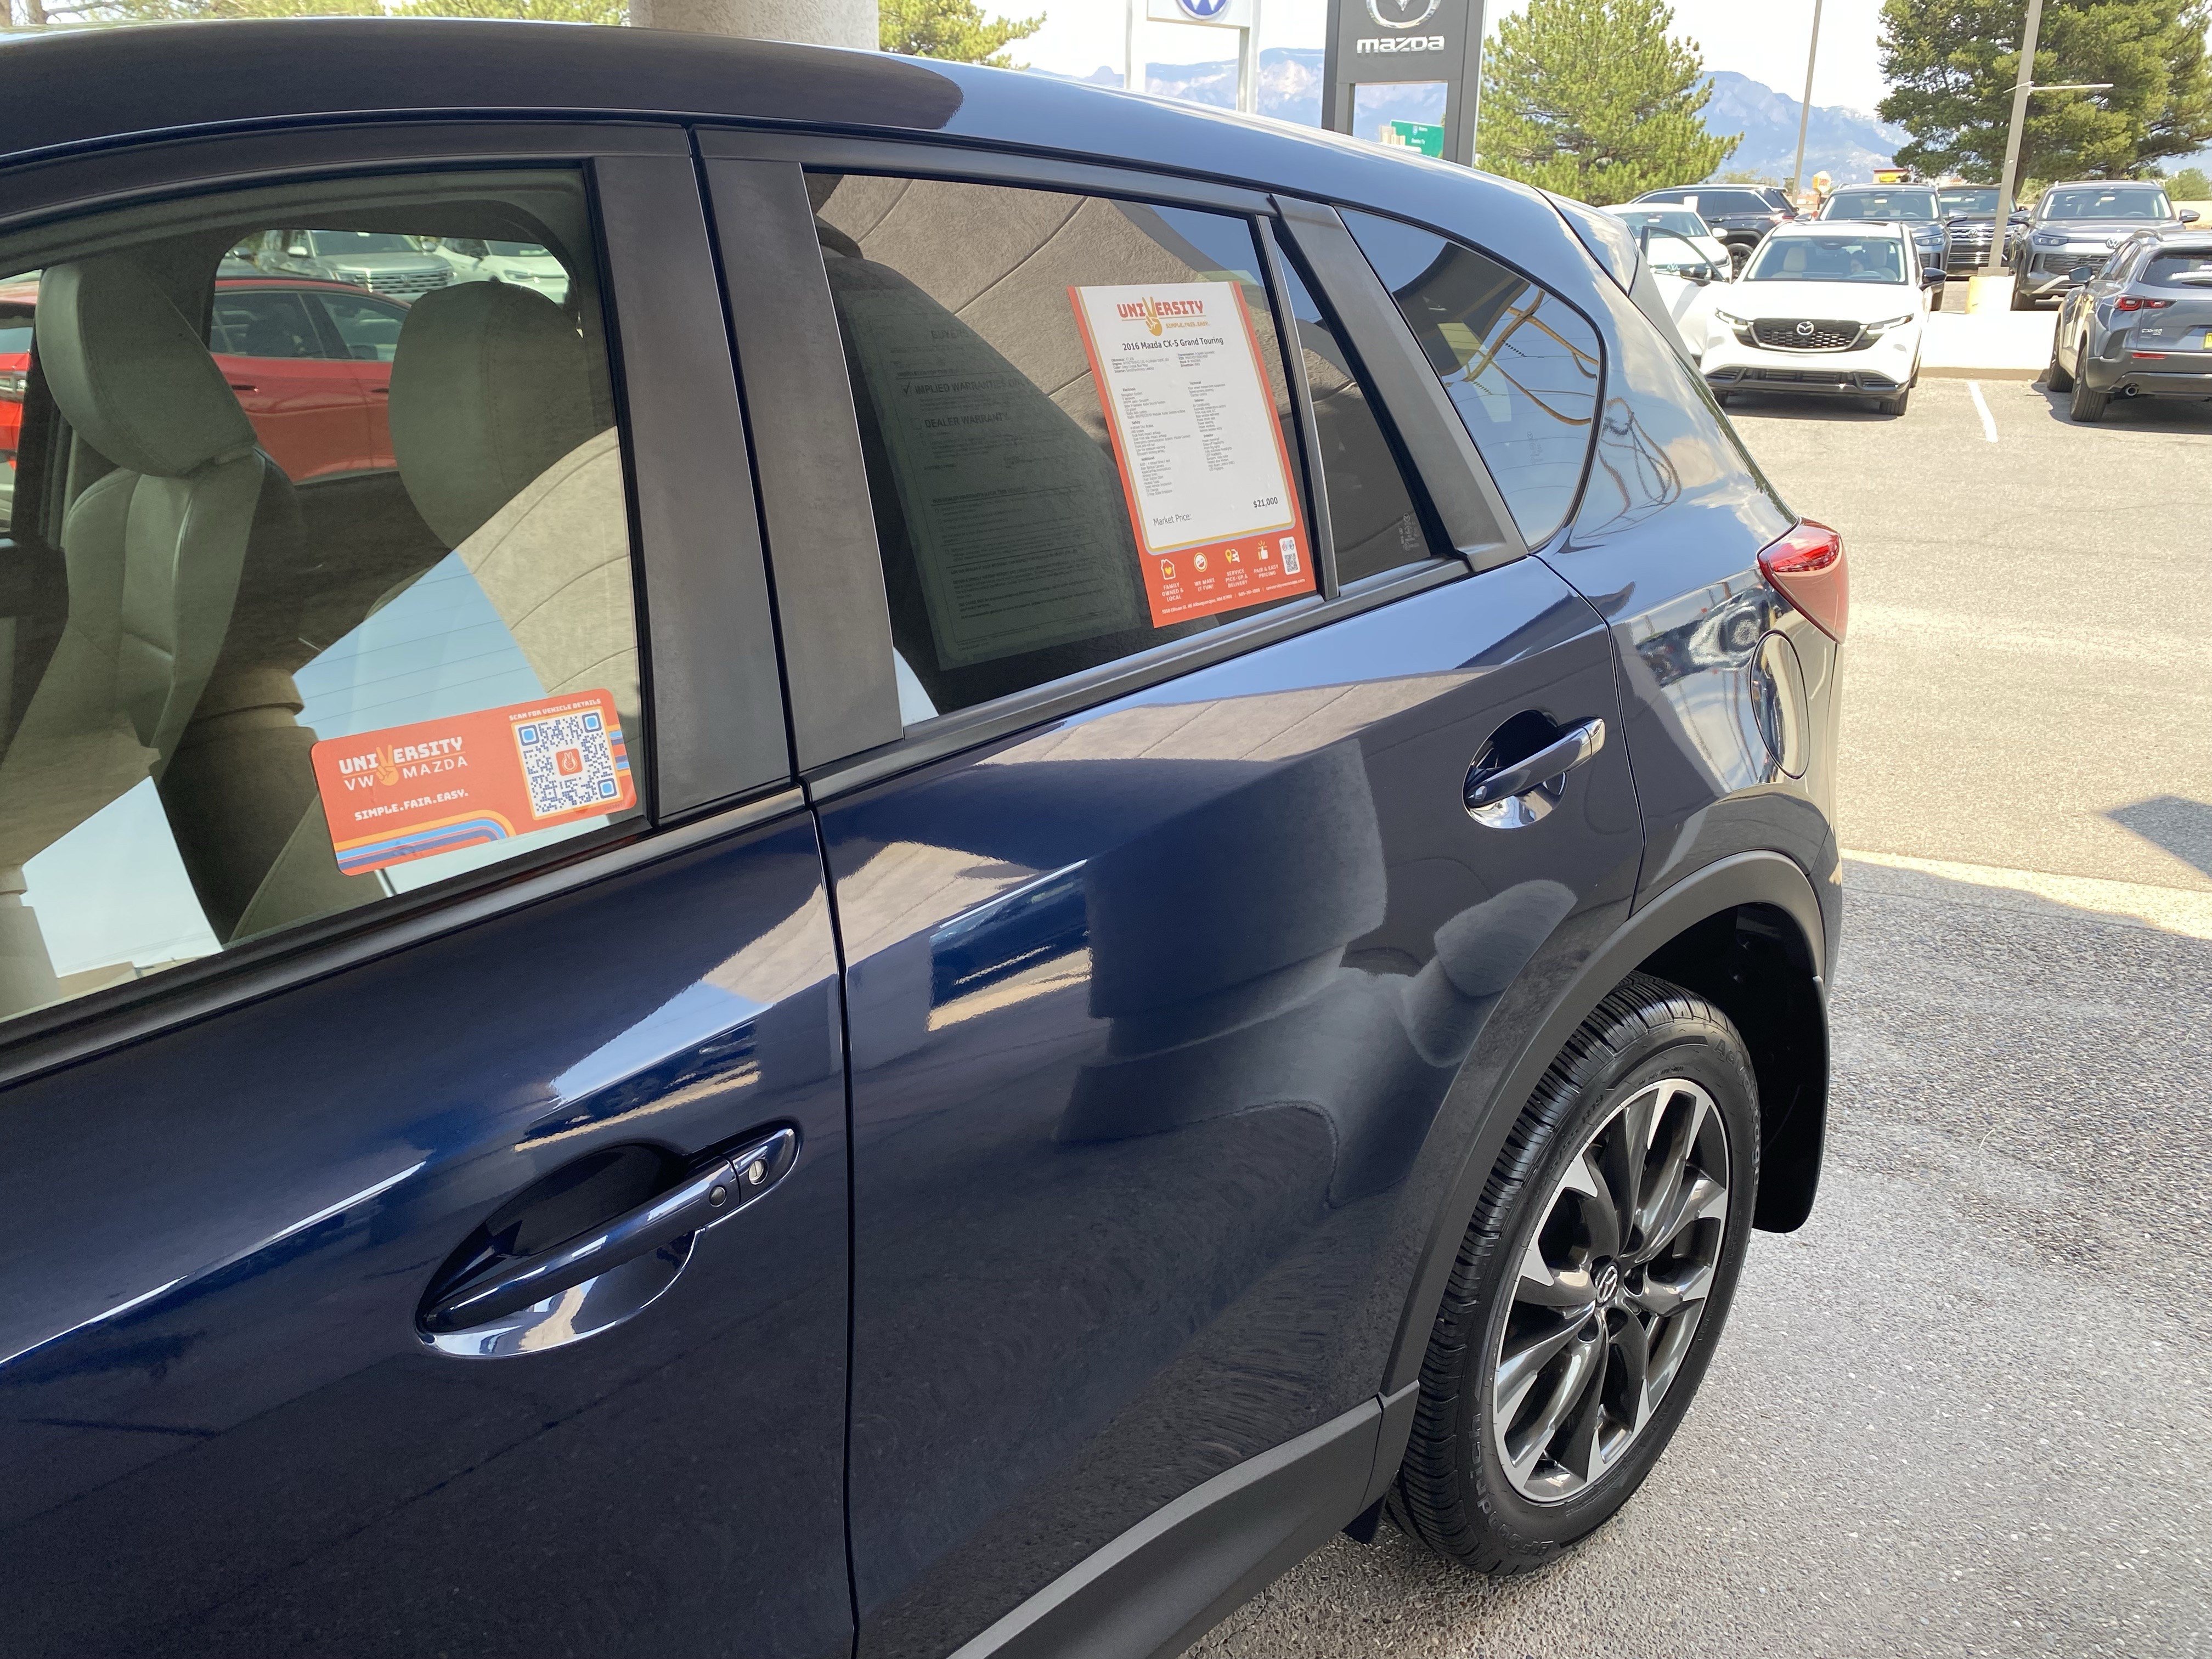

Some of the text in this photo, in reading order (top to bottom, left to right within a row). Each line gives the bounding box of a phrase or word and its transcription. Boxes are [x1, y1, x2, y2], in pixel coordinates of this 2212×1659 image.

[1357, 36, 1444, 54] mazda
[1117, 299, 1203, 318] UNIVERSITY
[1141, 341, 1162, 349] Mazda
[1163, 340, 1179, 348] CX-5
[1180, 338, 1199, 346] Grand
[1199, 336, 1224, 345] Touring
[915, 382, 950, 394] IMPLIED
[951, 379, 1006, 392] WARRANTIES
[924, 416, 960, 428] DEALER
[1153, 496, 1278, 526] Market Price: $21,000
[1227, 568, 1245, 577] SERVICE
[1163, 582, 1180, 590] FAMILY
[1228, 580, 1248, 588] DELIVERY
[1162, 589, 1180, 597] OWNED
[509, 698, 601, 721] SCAN FOR VEHICLE DETAILS
[338, 736, 463, 774] UNIVERSITY
[343, 756, 468, 791] VW MAZDA
[354, 789, 469, 821] SIMPLE.FAIR.EASY.
